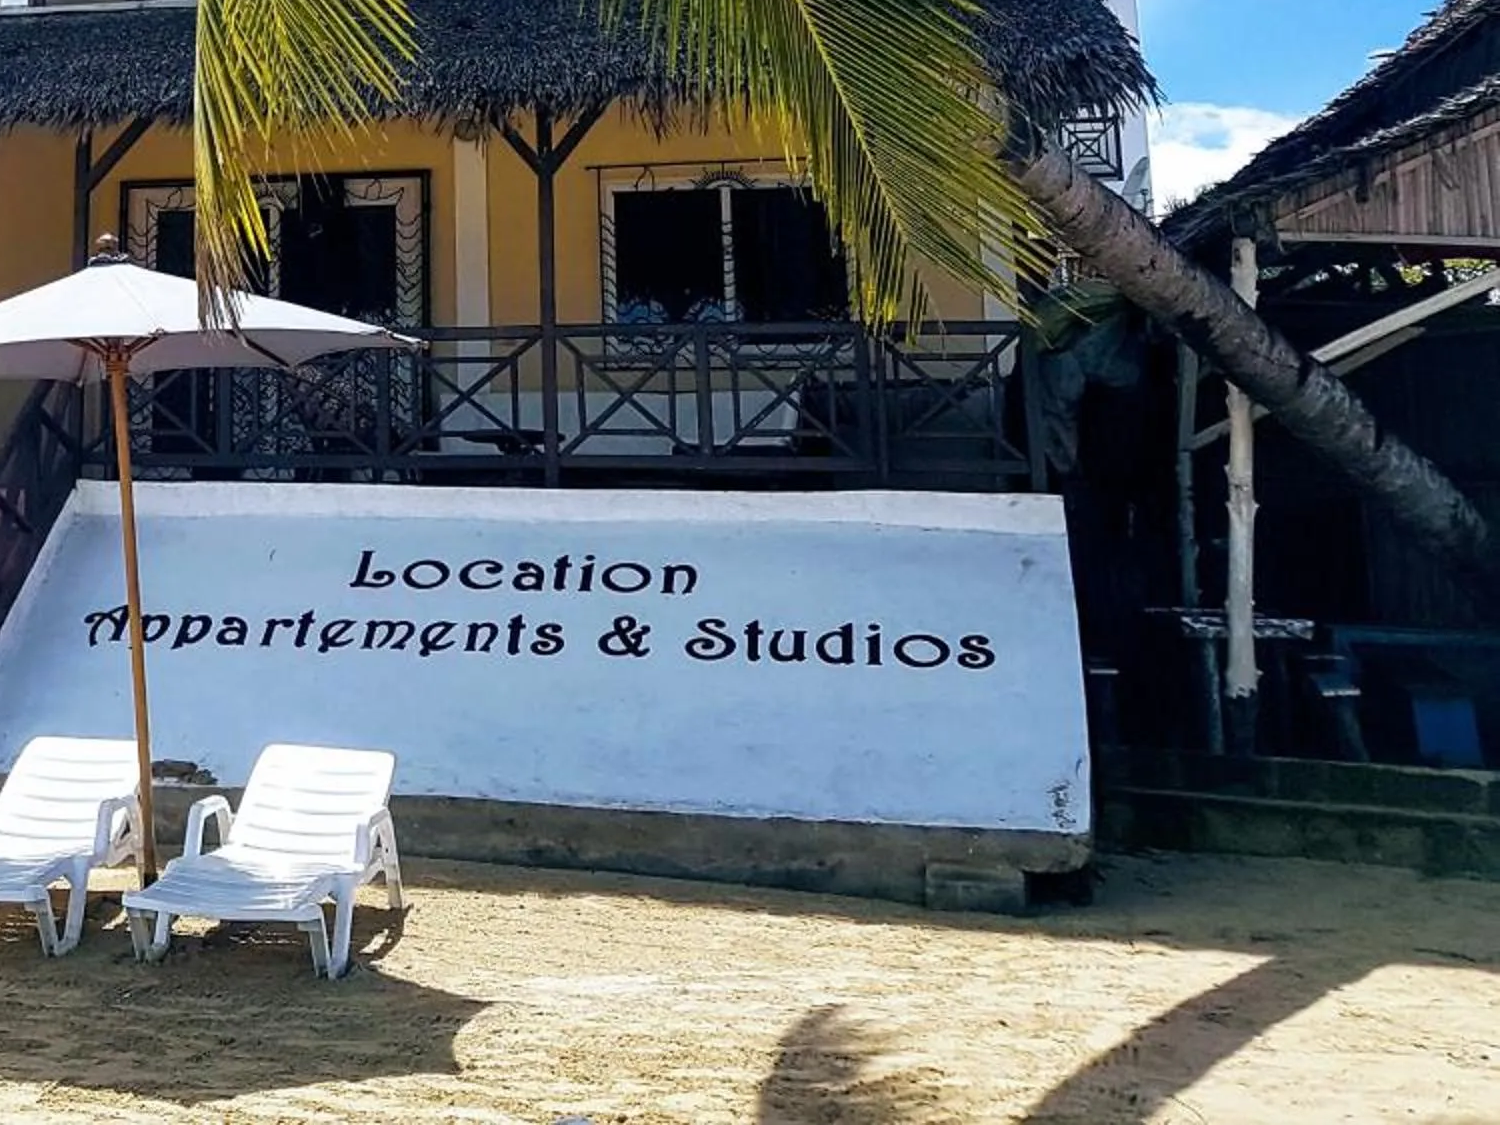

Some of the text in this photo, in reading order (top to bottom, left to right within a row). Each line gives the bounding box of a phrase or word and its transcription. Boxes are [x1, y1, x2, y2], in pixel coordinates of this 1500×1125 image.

[349, 549, 699, 595] Location
[83, 604, 997, 670] Appartements & Studios
